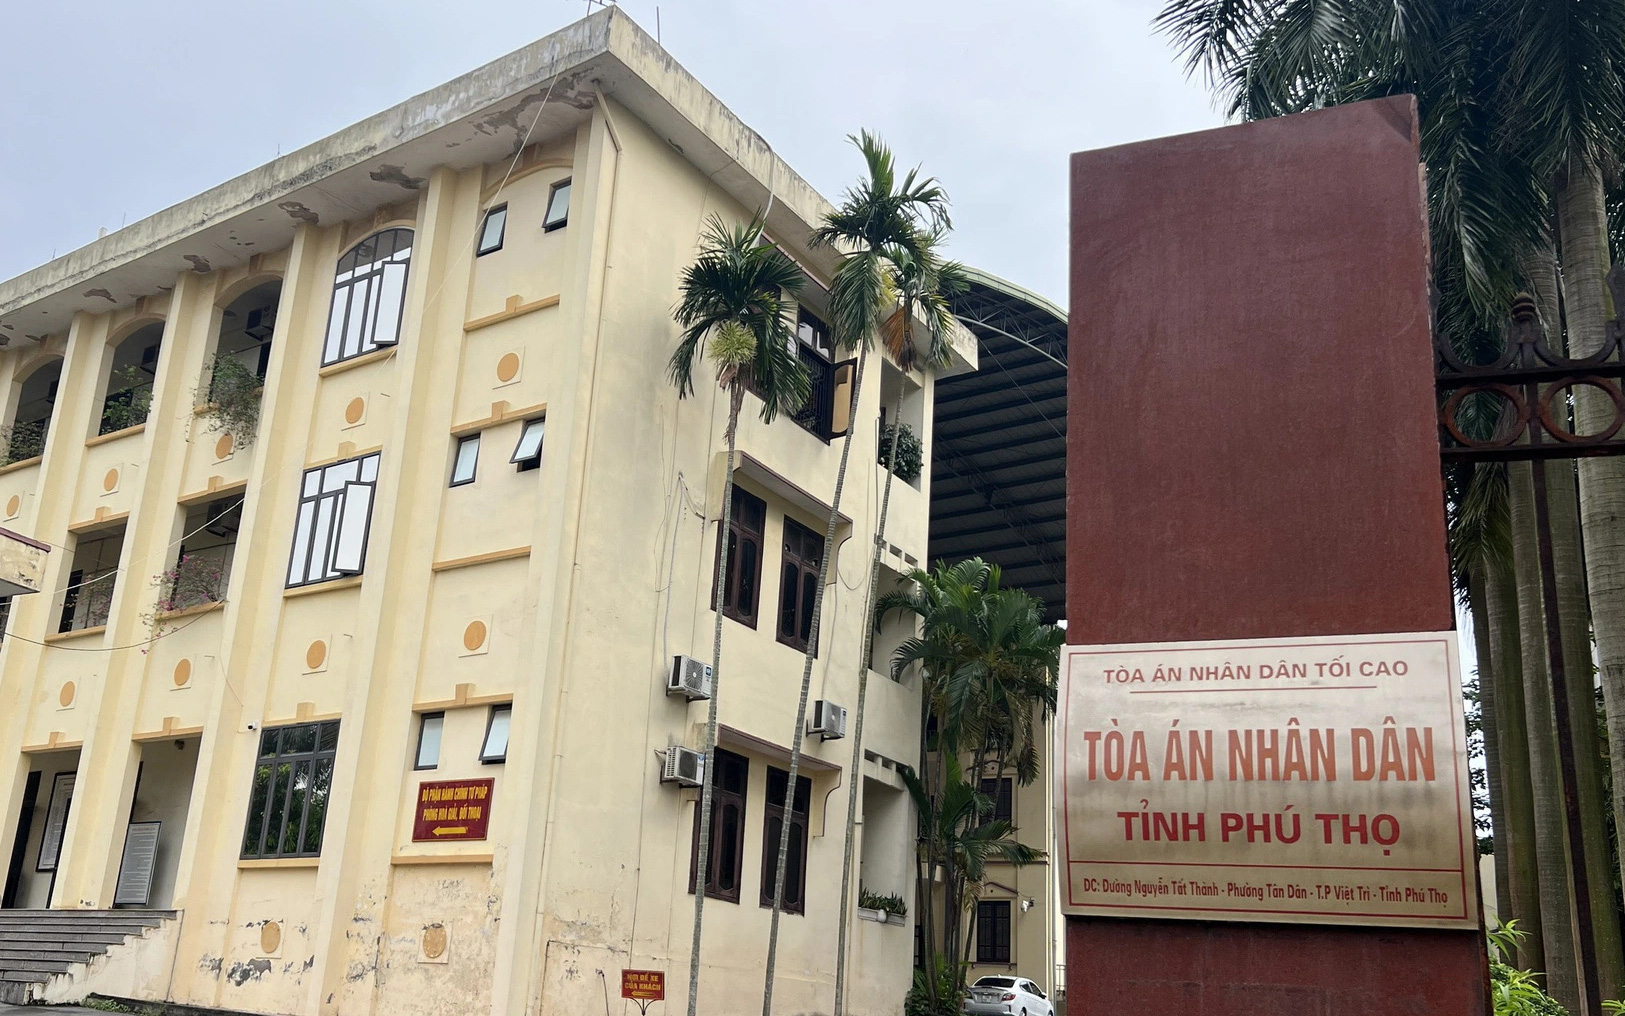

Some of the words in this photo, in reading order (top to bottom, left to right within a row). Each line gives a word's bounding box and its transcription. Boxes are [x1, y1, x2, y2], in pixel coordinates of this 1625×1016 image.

[1103, 663, 1145, 684] TÒA
[1152, 664, 1182, 682] ÁN
[1189, 661, 1251, 681] NHÂN
[1259, 659, 1307, 680] DÂN
[1314, 654, 1351, 678] TỐI
[1358, 660, 1408, 677] CAO
[1083, 718, 1150, 781] TÒA
[1163, 718, 1213, 781] ÁN
[1229, 717, 1336, 782] NHÂN
[1351, 715, 1435, 782] DÂN
[1117, 798, 1206, 842] TỈNH
[1220, 804, 1301, 845] PHÚ
[1314, 812, 1401, 857] THỌ
[1134, 877, 1169, 898] Nguyễn
[1171, 878, 1187, 896] Tất
[1189, 880, 1219, 896] Thành
[1227, 882, 1264, 901] Phường
[1266, 883, 1284, 899] Tân
[1287, 884, 1307, 900] Dân
[1333, 885, 1354, 906] Việt
[1356, 885, 1370, 901] Trì
[1379, 884, 1402, 903] Tỉnh
[1405, 886, 1425, 903] Phú
[1427, 887, 1448, 908] Thọ
